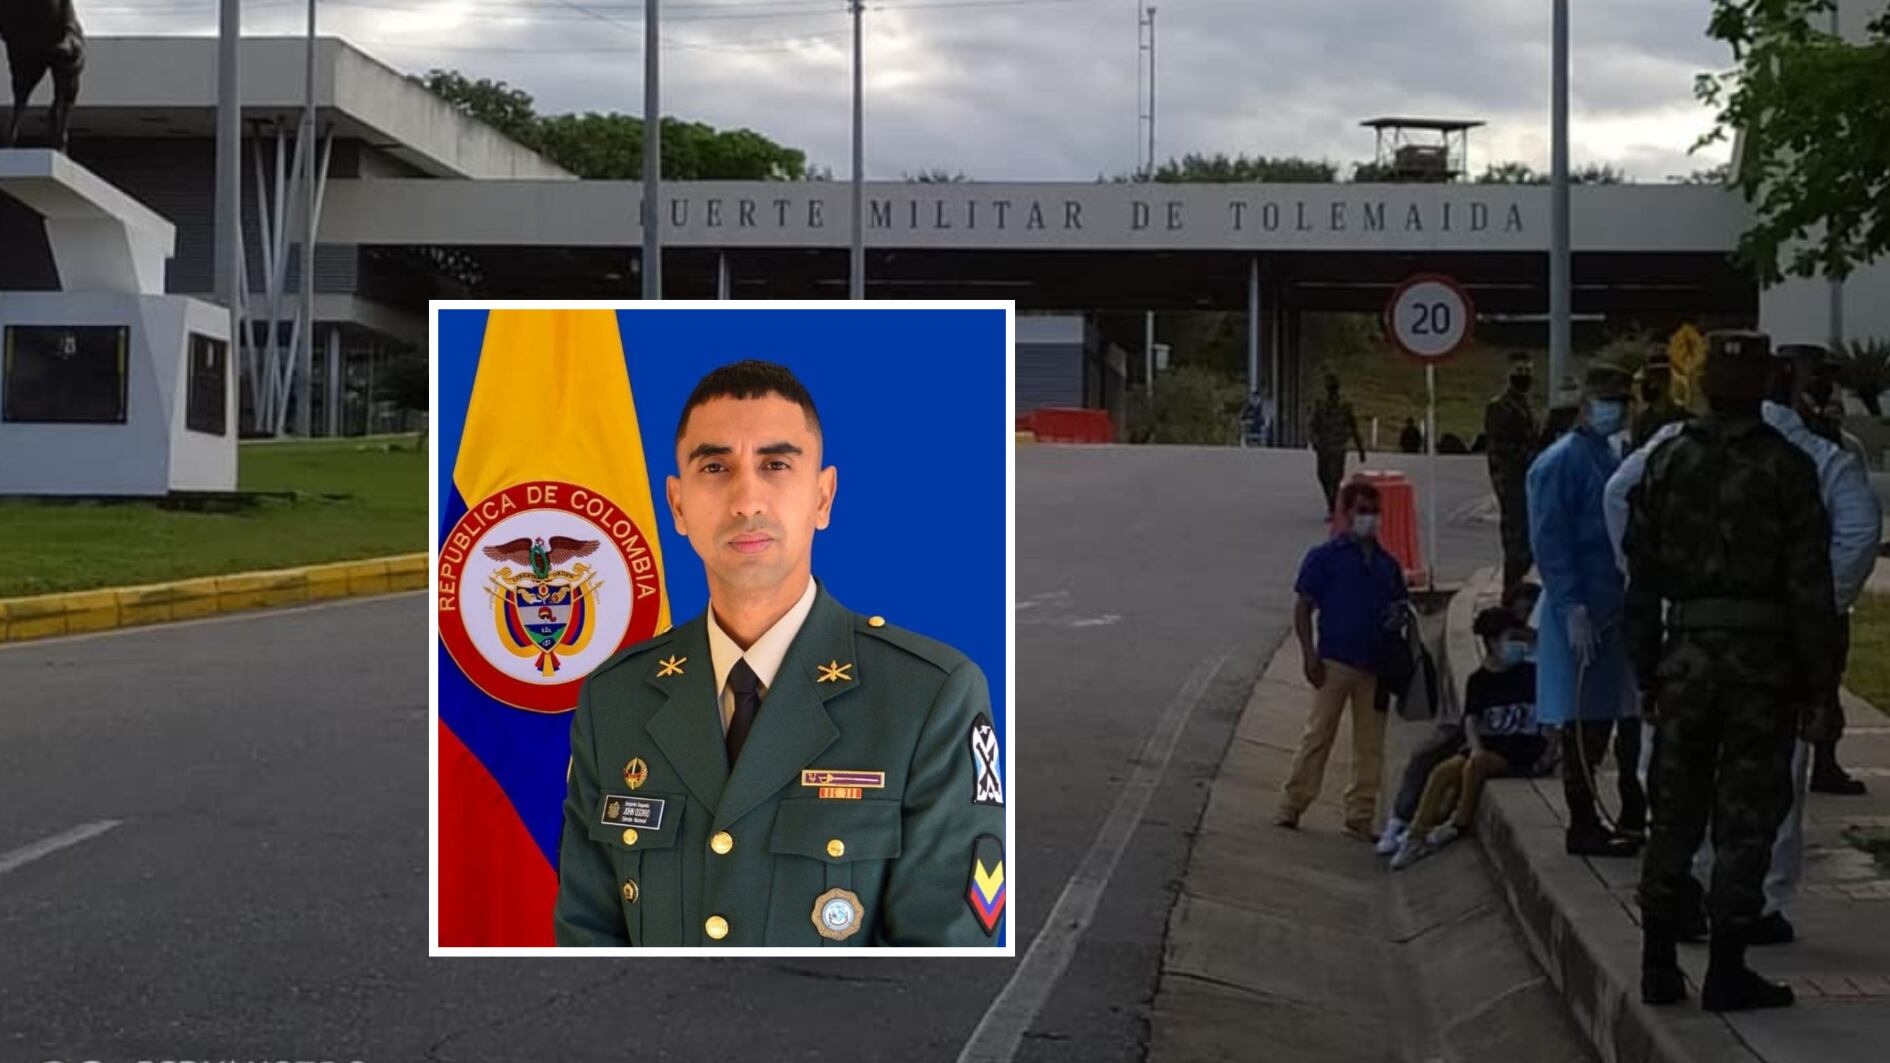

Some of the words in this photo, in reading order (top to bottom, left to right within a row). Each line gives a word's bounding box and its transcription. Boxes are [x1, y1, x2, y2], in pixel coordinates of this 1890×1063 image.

[638, 199, 825, 227] UERTE
[869, 199, 1083, 230] MILITAR
[1131, 201, 1184, 231] DE
[1230, 201, 1524, 232] TOLEMAIDA
[1411, 302, 1450, 334] 20
[439, 493, 517, 611] REPUBLICA
[526, 485, 559, 504] DE
[570, 490, 657, 600] COLOMBIA
